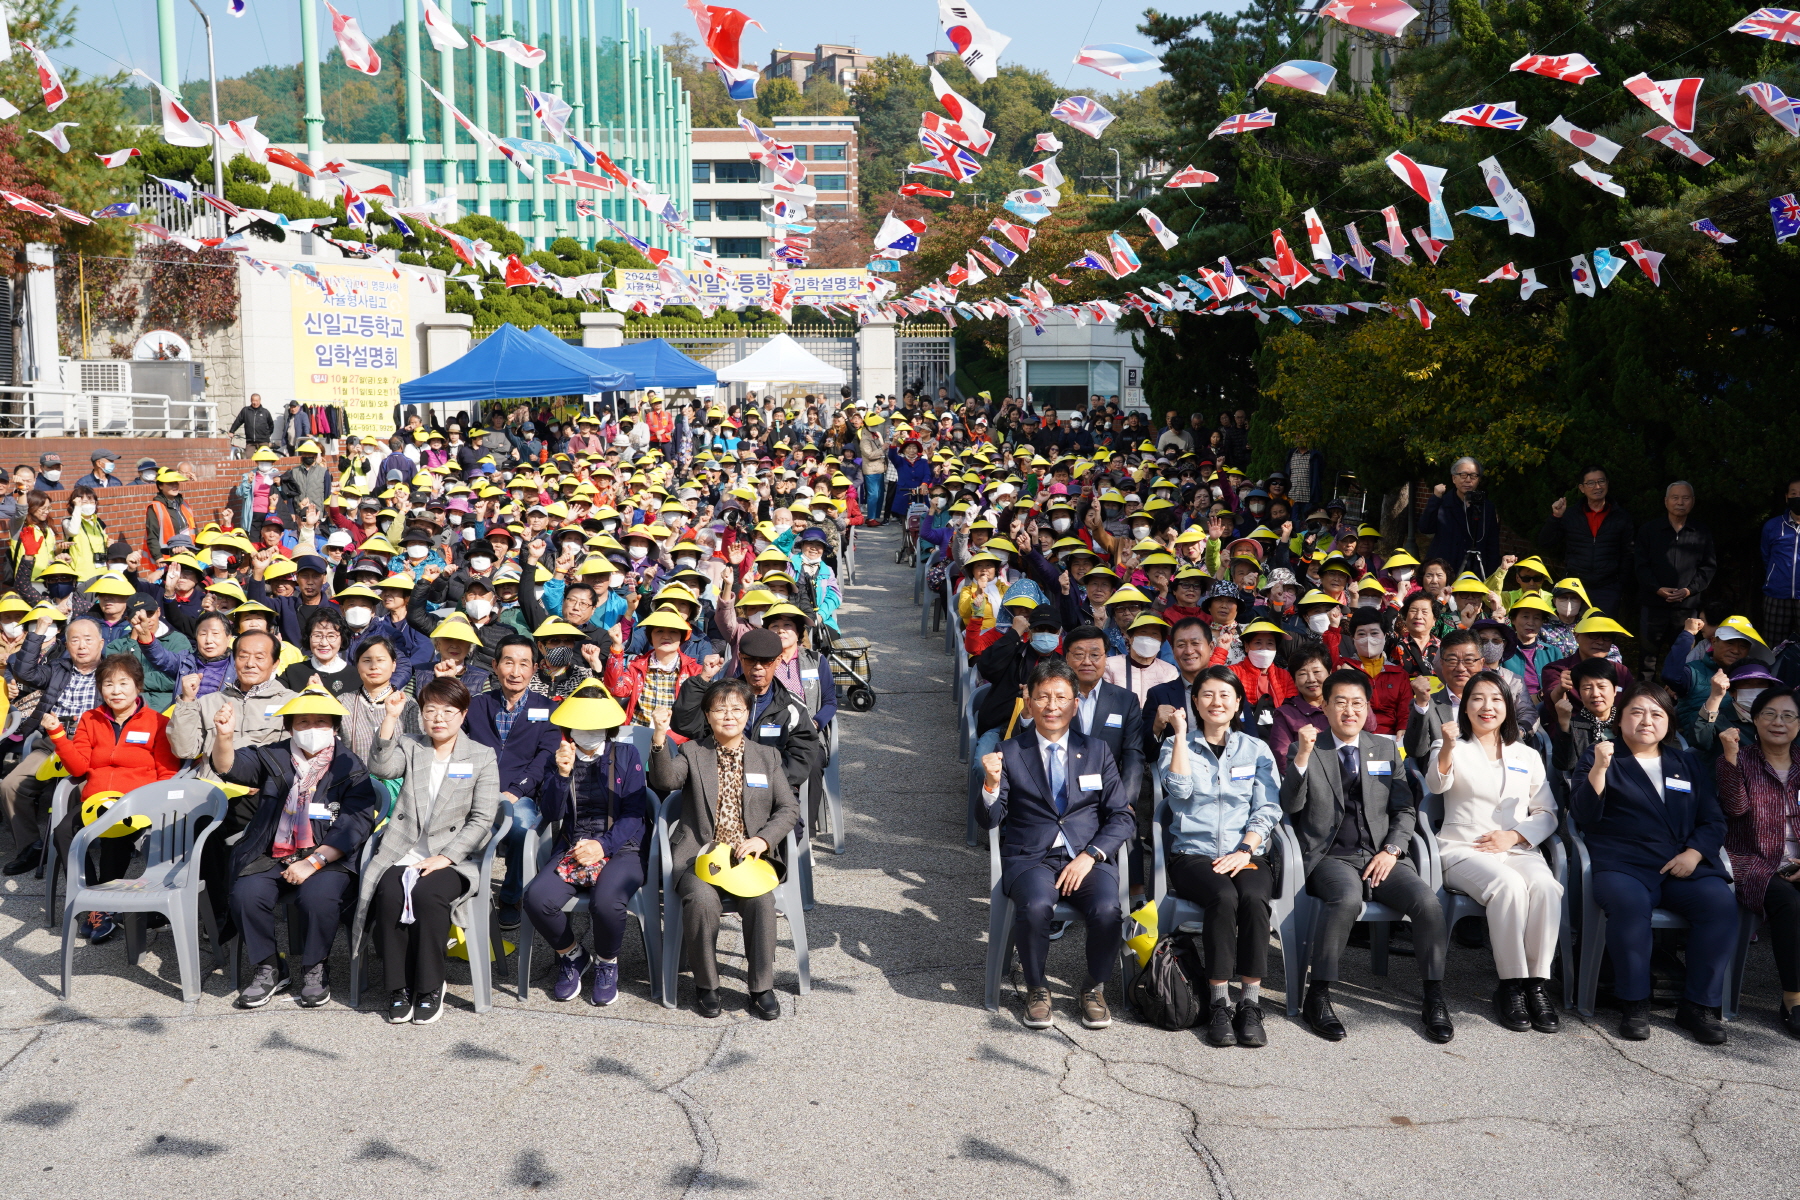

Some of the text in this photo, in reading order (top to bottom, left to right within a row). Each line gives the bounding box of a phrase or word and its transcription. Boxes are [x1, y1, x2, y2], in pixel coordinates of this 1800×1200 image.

[371, 280, 398, 293] 명문사학
[794, 275, 861, 291] 입학설명회
[323, 293, 388, 309] 자율형사립고
[304, 313, 405, 338] 신일고등학교
[315, 344, 398, 370] 입학설명회
[313, 374, 327, 383] 일시
[331, 374, 347, 384] 10월
[349, 374, 376, 384] 27일(금)
[377, 376, 389, 384] 오후
[333, 387, 348, 396] 11월
[351, 387, 376, 396] 11일(토)
[377, 388, 389, 396] 오전
[349, 398, 376, 408] 27일(월)
[377, 400, 389, 408] 오후
[380, 424, 394, 432] 9925
